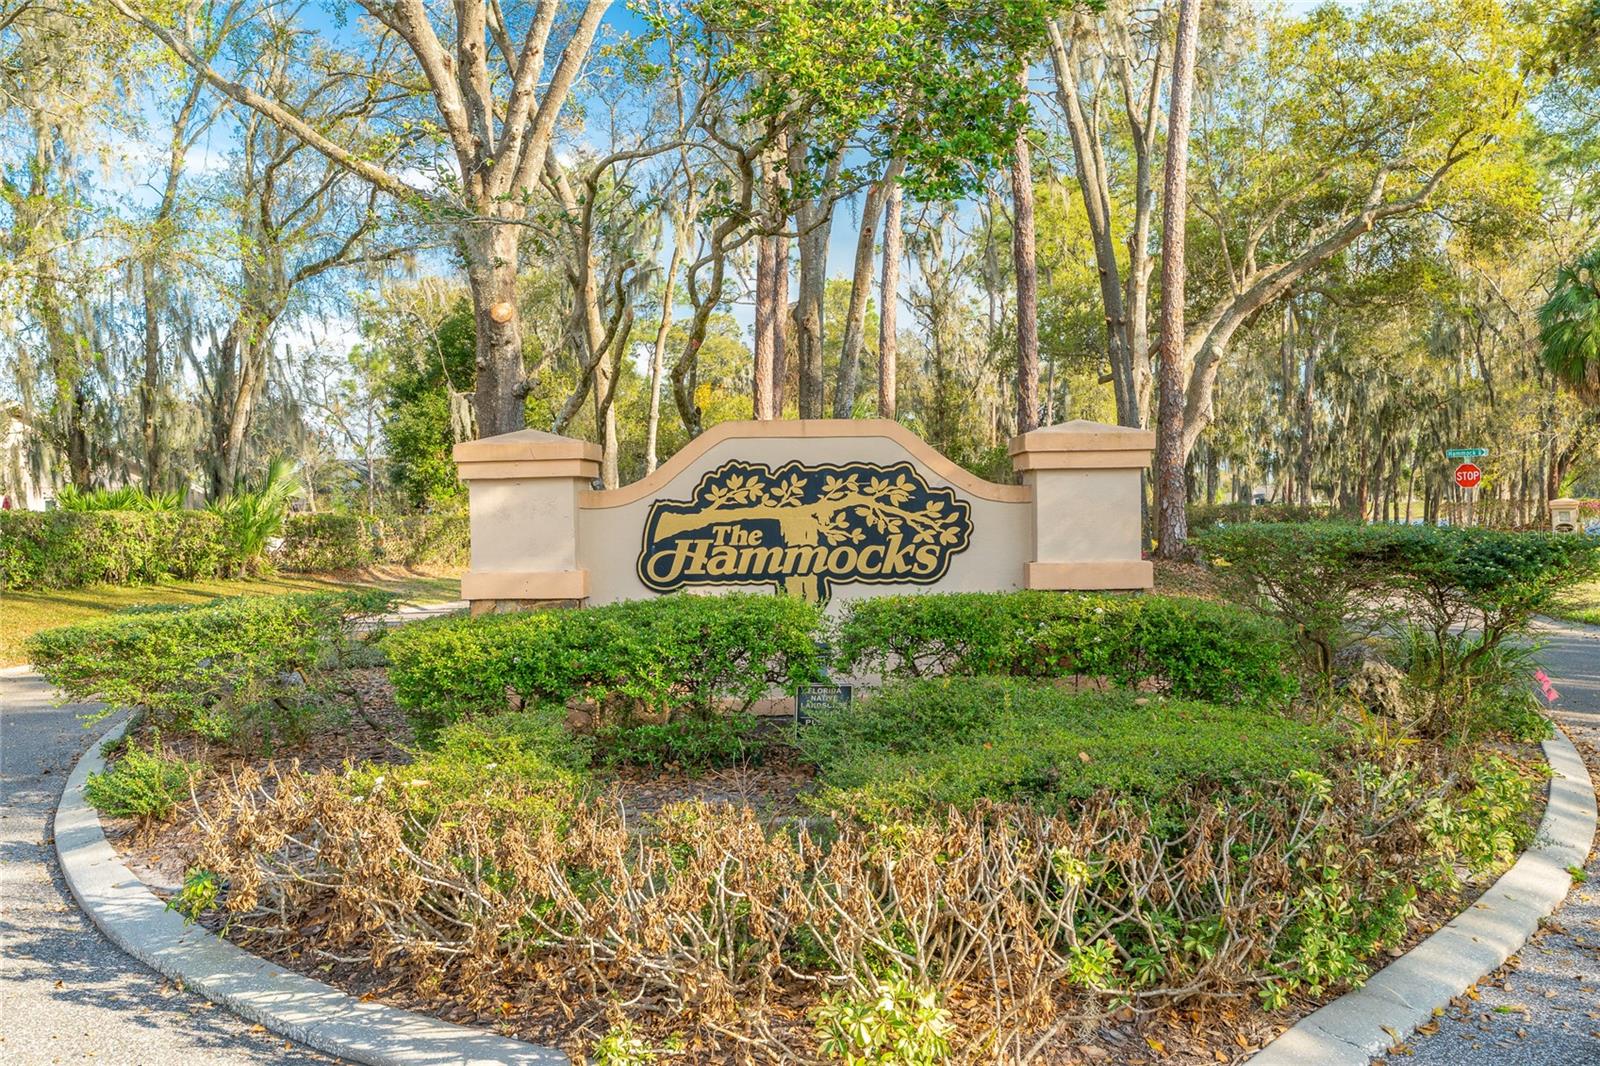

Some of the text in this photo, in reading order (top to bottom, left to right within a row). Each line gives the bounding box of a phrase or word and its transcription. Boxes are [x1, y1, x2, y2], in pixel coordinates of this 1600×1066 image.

[1456, 471, 1480, 481] STOP
[711, 525, 764, 547] The
[646, 533, 942, 583] Hammocks
